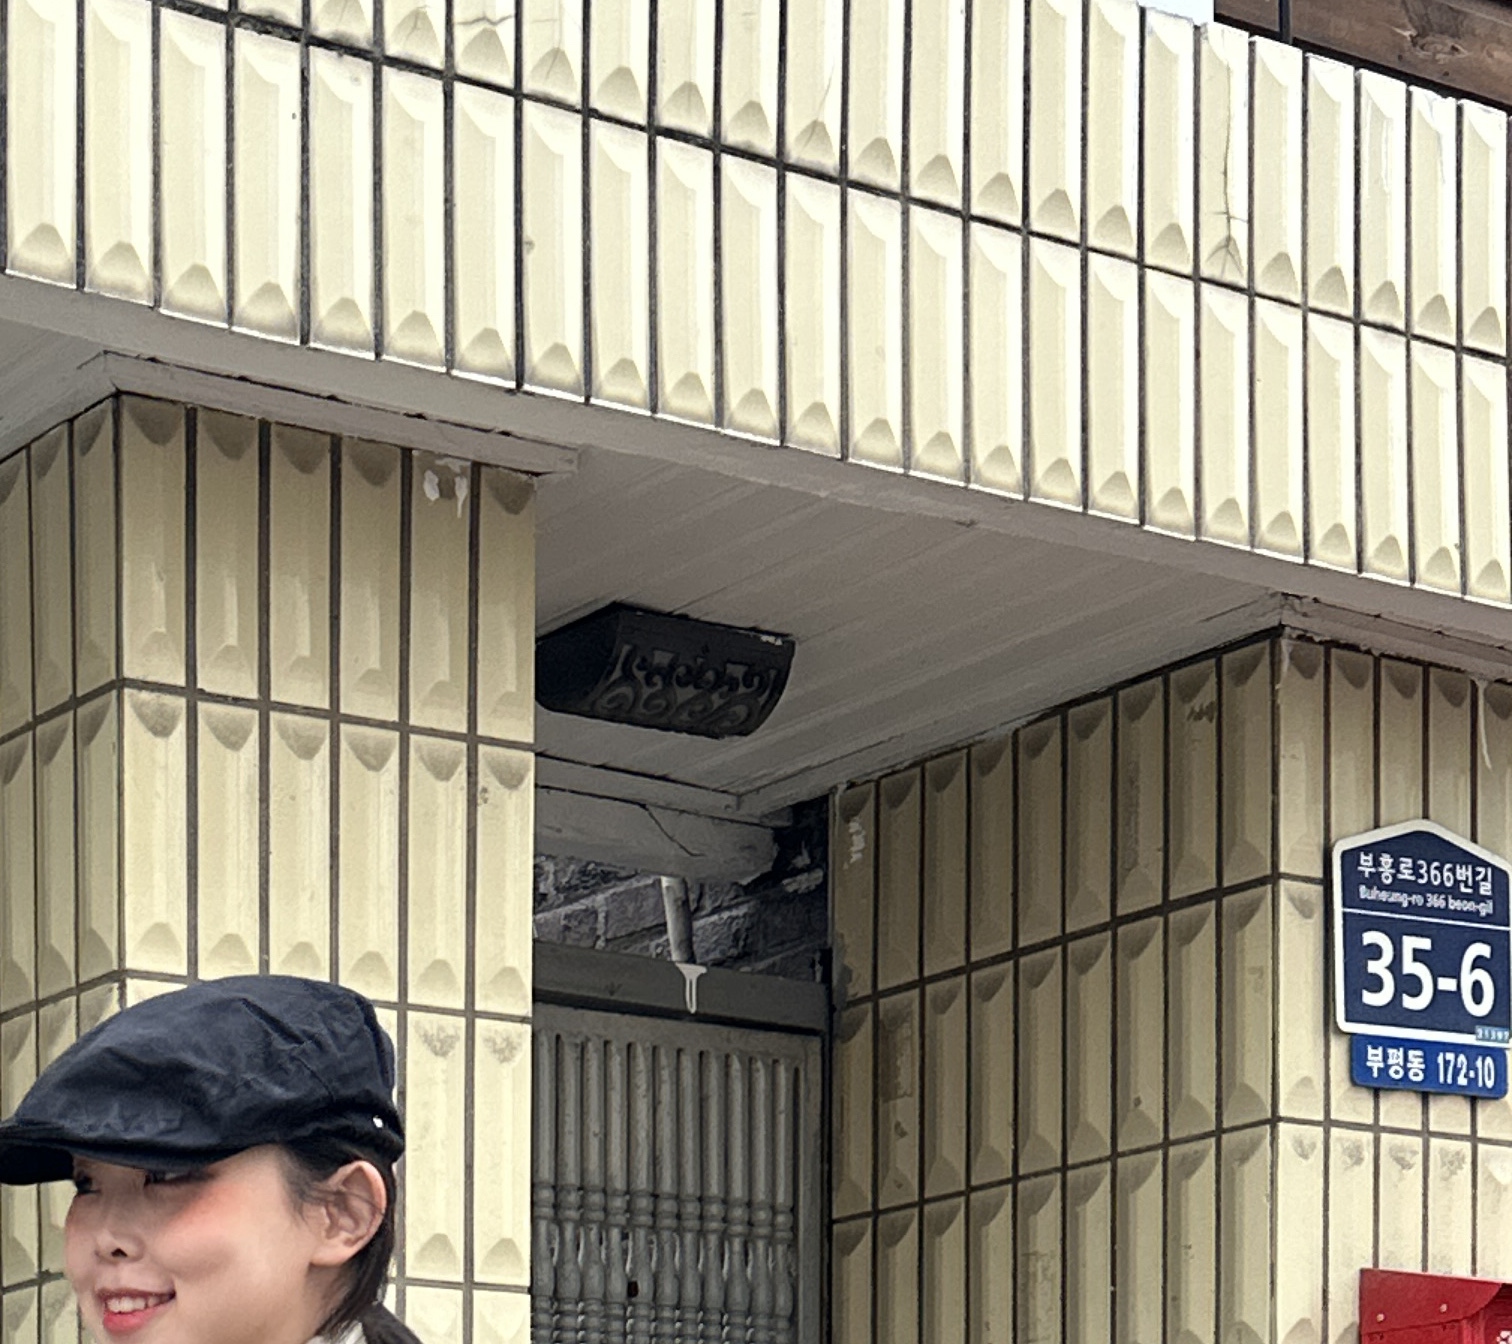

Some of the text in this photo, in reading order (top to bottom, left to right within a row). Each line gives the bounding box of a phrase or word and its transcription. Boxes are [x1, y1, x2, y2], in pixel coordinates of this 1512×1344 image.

[1357, 852, 1492, 895] 부흥로366번길
[1361, 930, 1495, 1017] 35-6
[1366, 1045, 1495, 1089] 부평동 172-10
